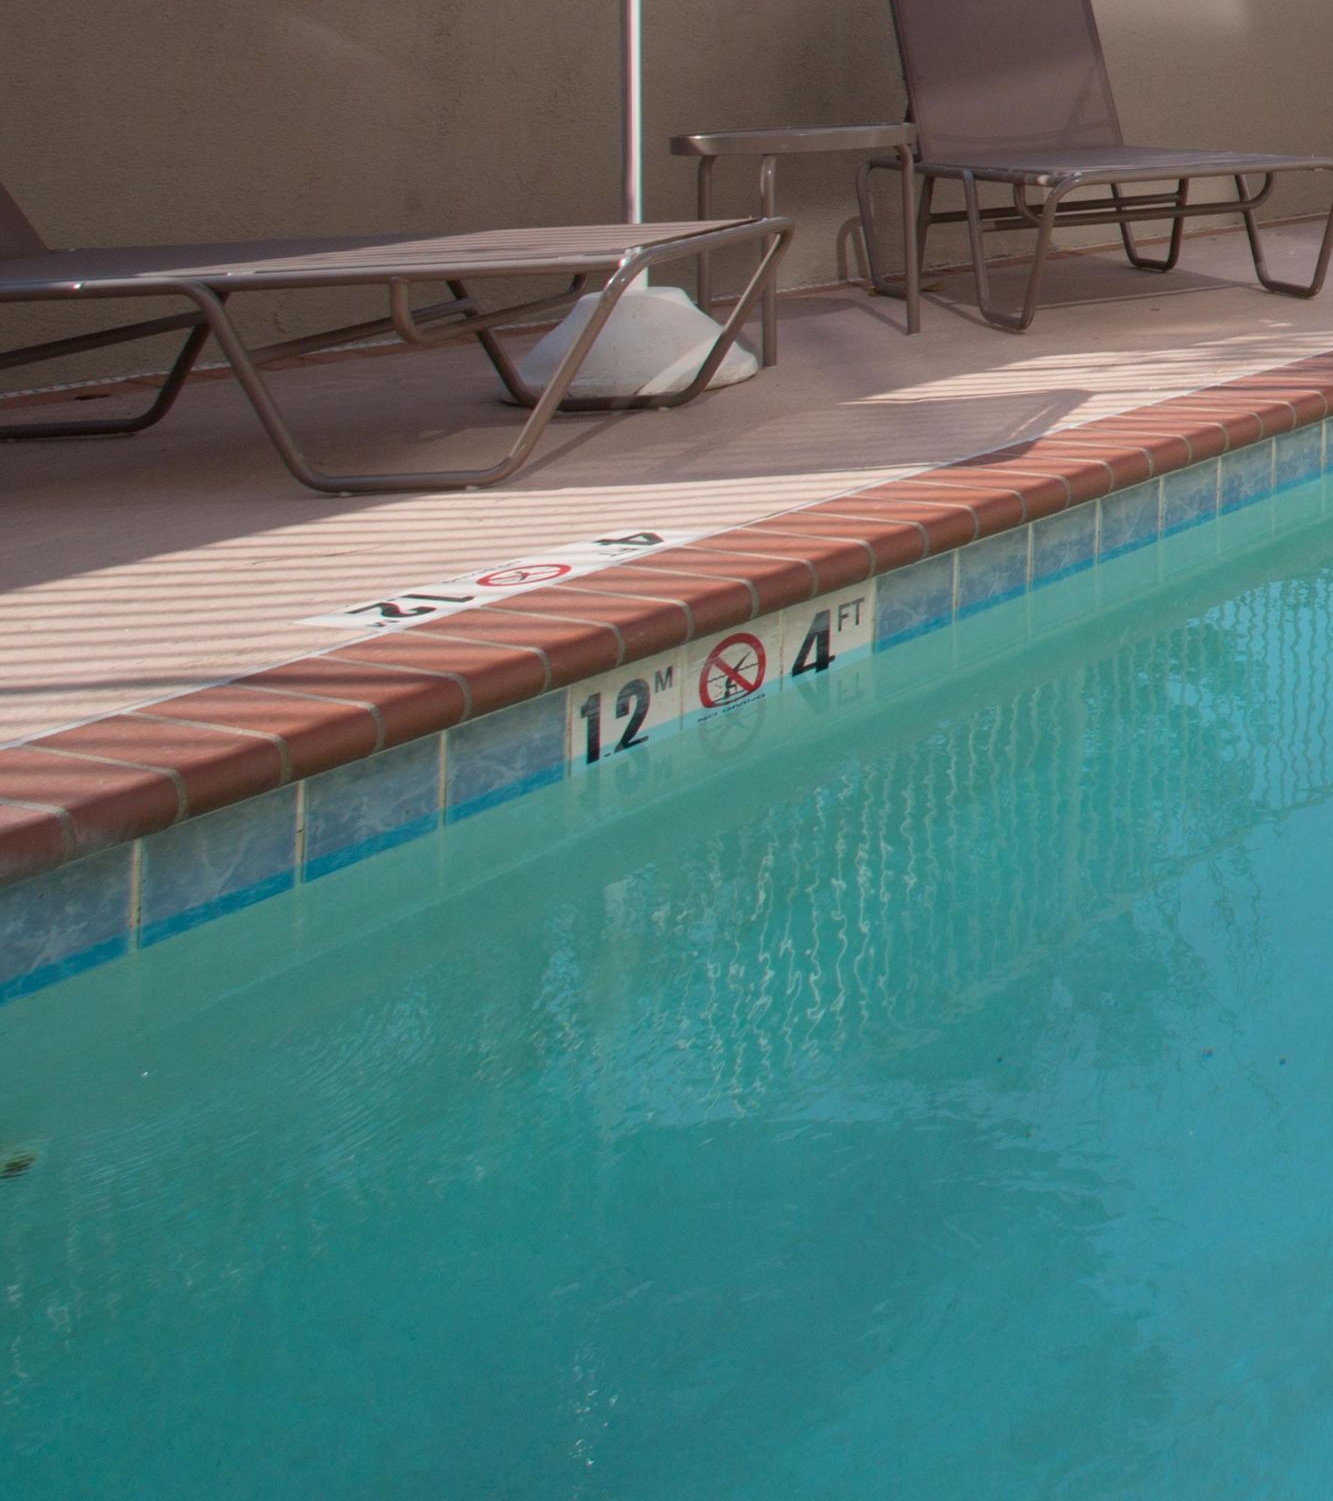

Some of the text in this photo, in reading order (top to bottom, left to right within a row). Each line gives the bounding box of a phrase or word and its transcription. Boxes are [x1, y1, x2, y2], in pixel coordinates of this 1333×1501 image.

[592, 532, 665, 546] 4
[791, 597, 865, 677] 4 FT
[655, 665, 673, 694] M
